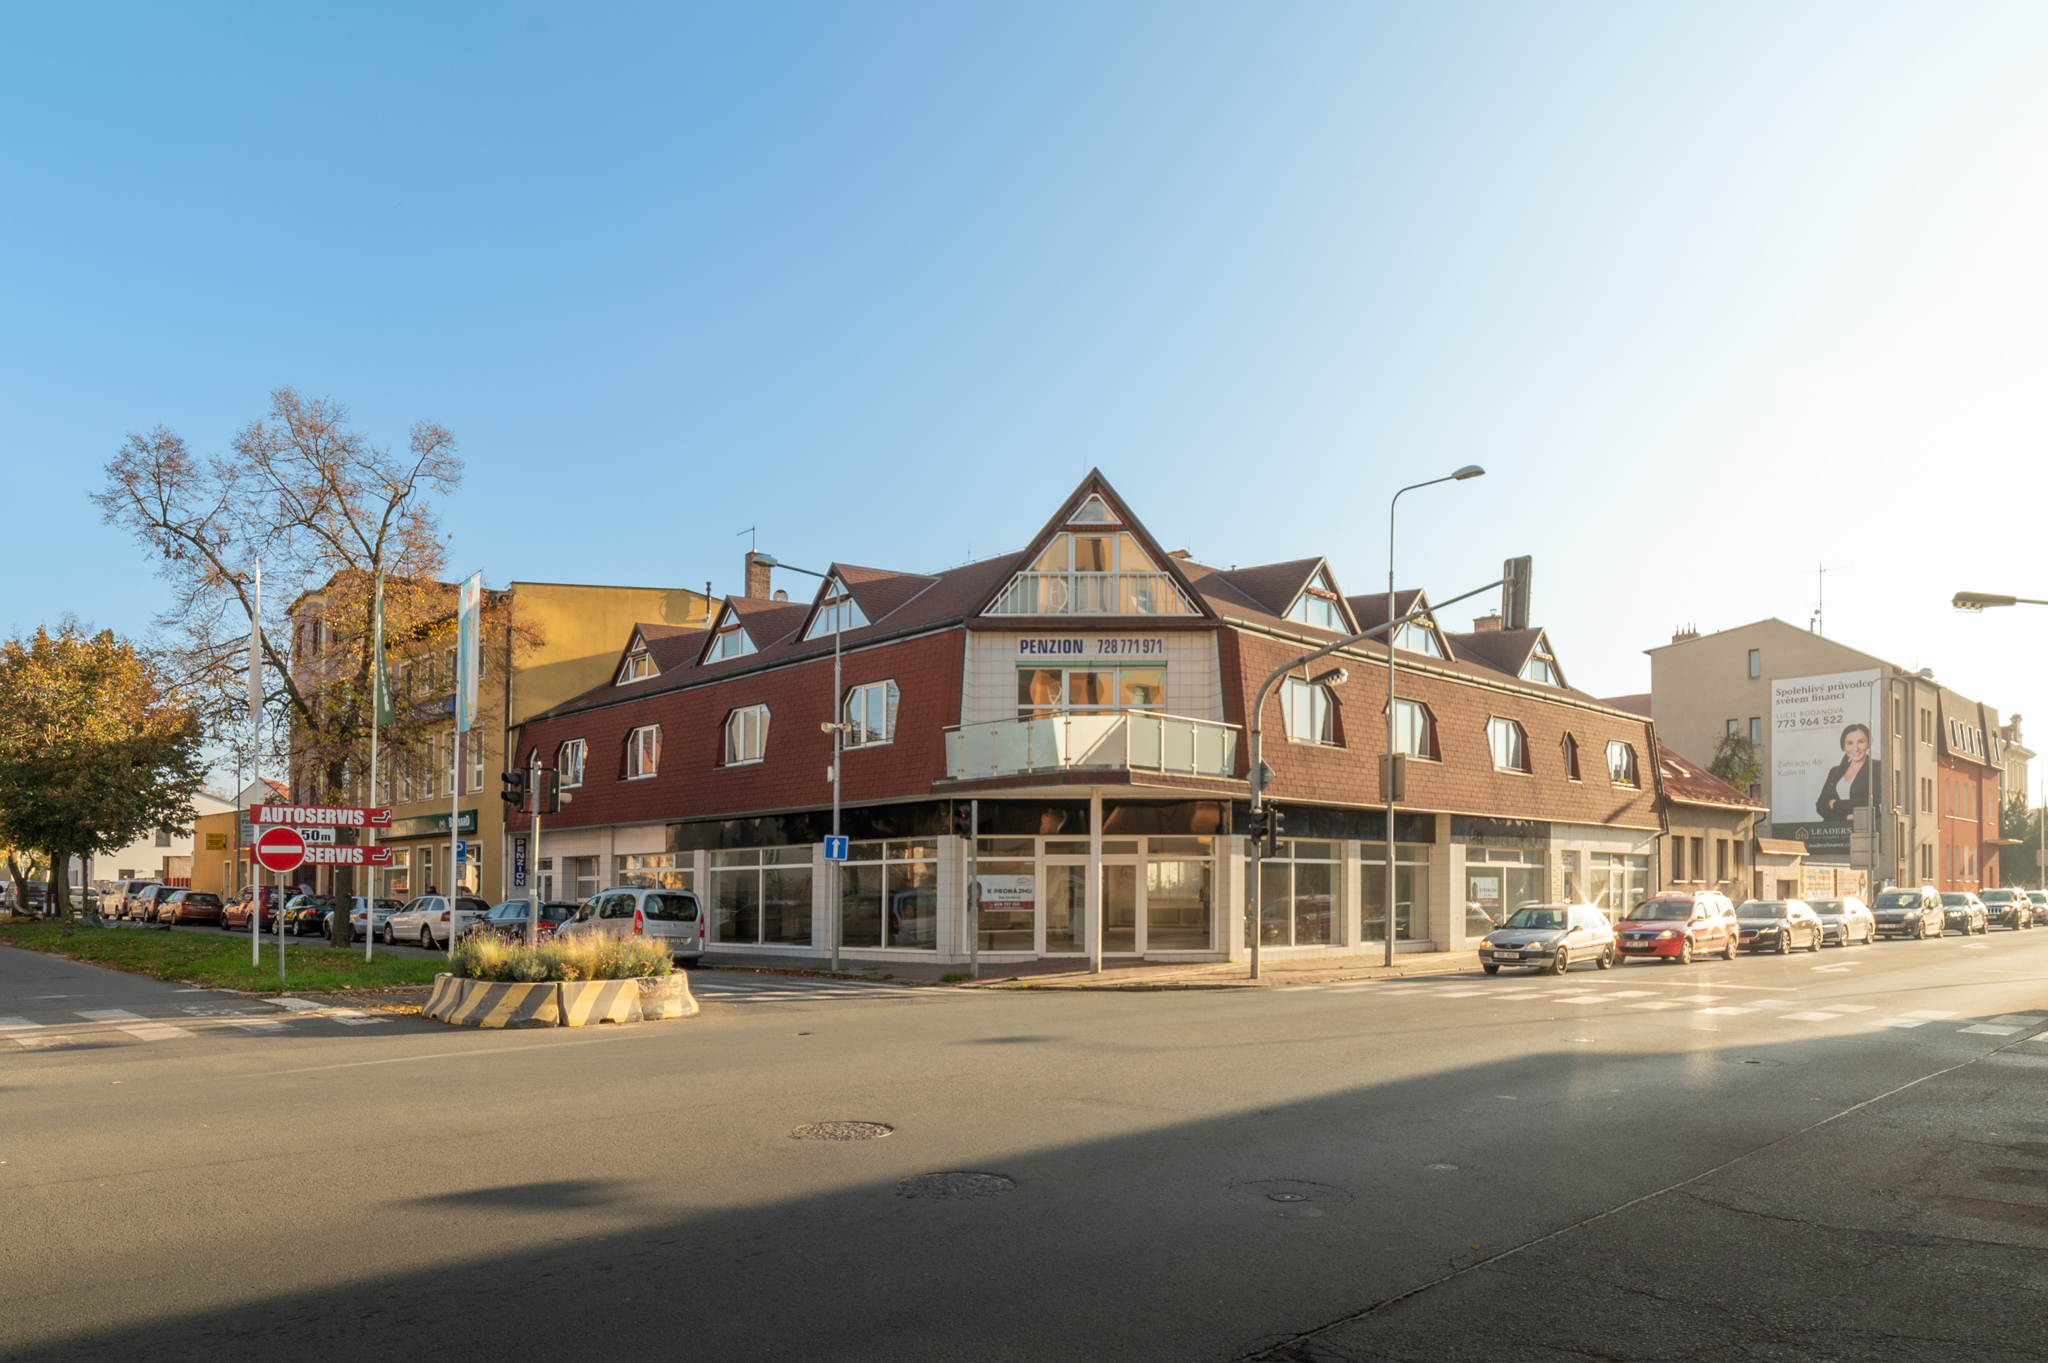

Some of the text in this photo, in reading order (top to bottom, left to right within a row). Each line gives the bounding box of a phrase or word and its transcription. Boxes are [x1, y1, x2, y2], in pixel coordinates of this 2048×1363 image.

[1020, 639, 1162, 654] PENZION 728 771 971
[1776, 680, 1873, 697] Spolehlivý průvodce
[1776, 691, 1845, 705] světem financí
[1777, 715, 1843, 728] 773 964 522
[260, 807, 364, 825] AUTOSERVIS
[301, 829, 331, 841] 50m
[1811, 827, 1853, 835] LEADERS
[516, 839, 525, 886] PENZION
